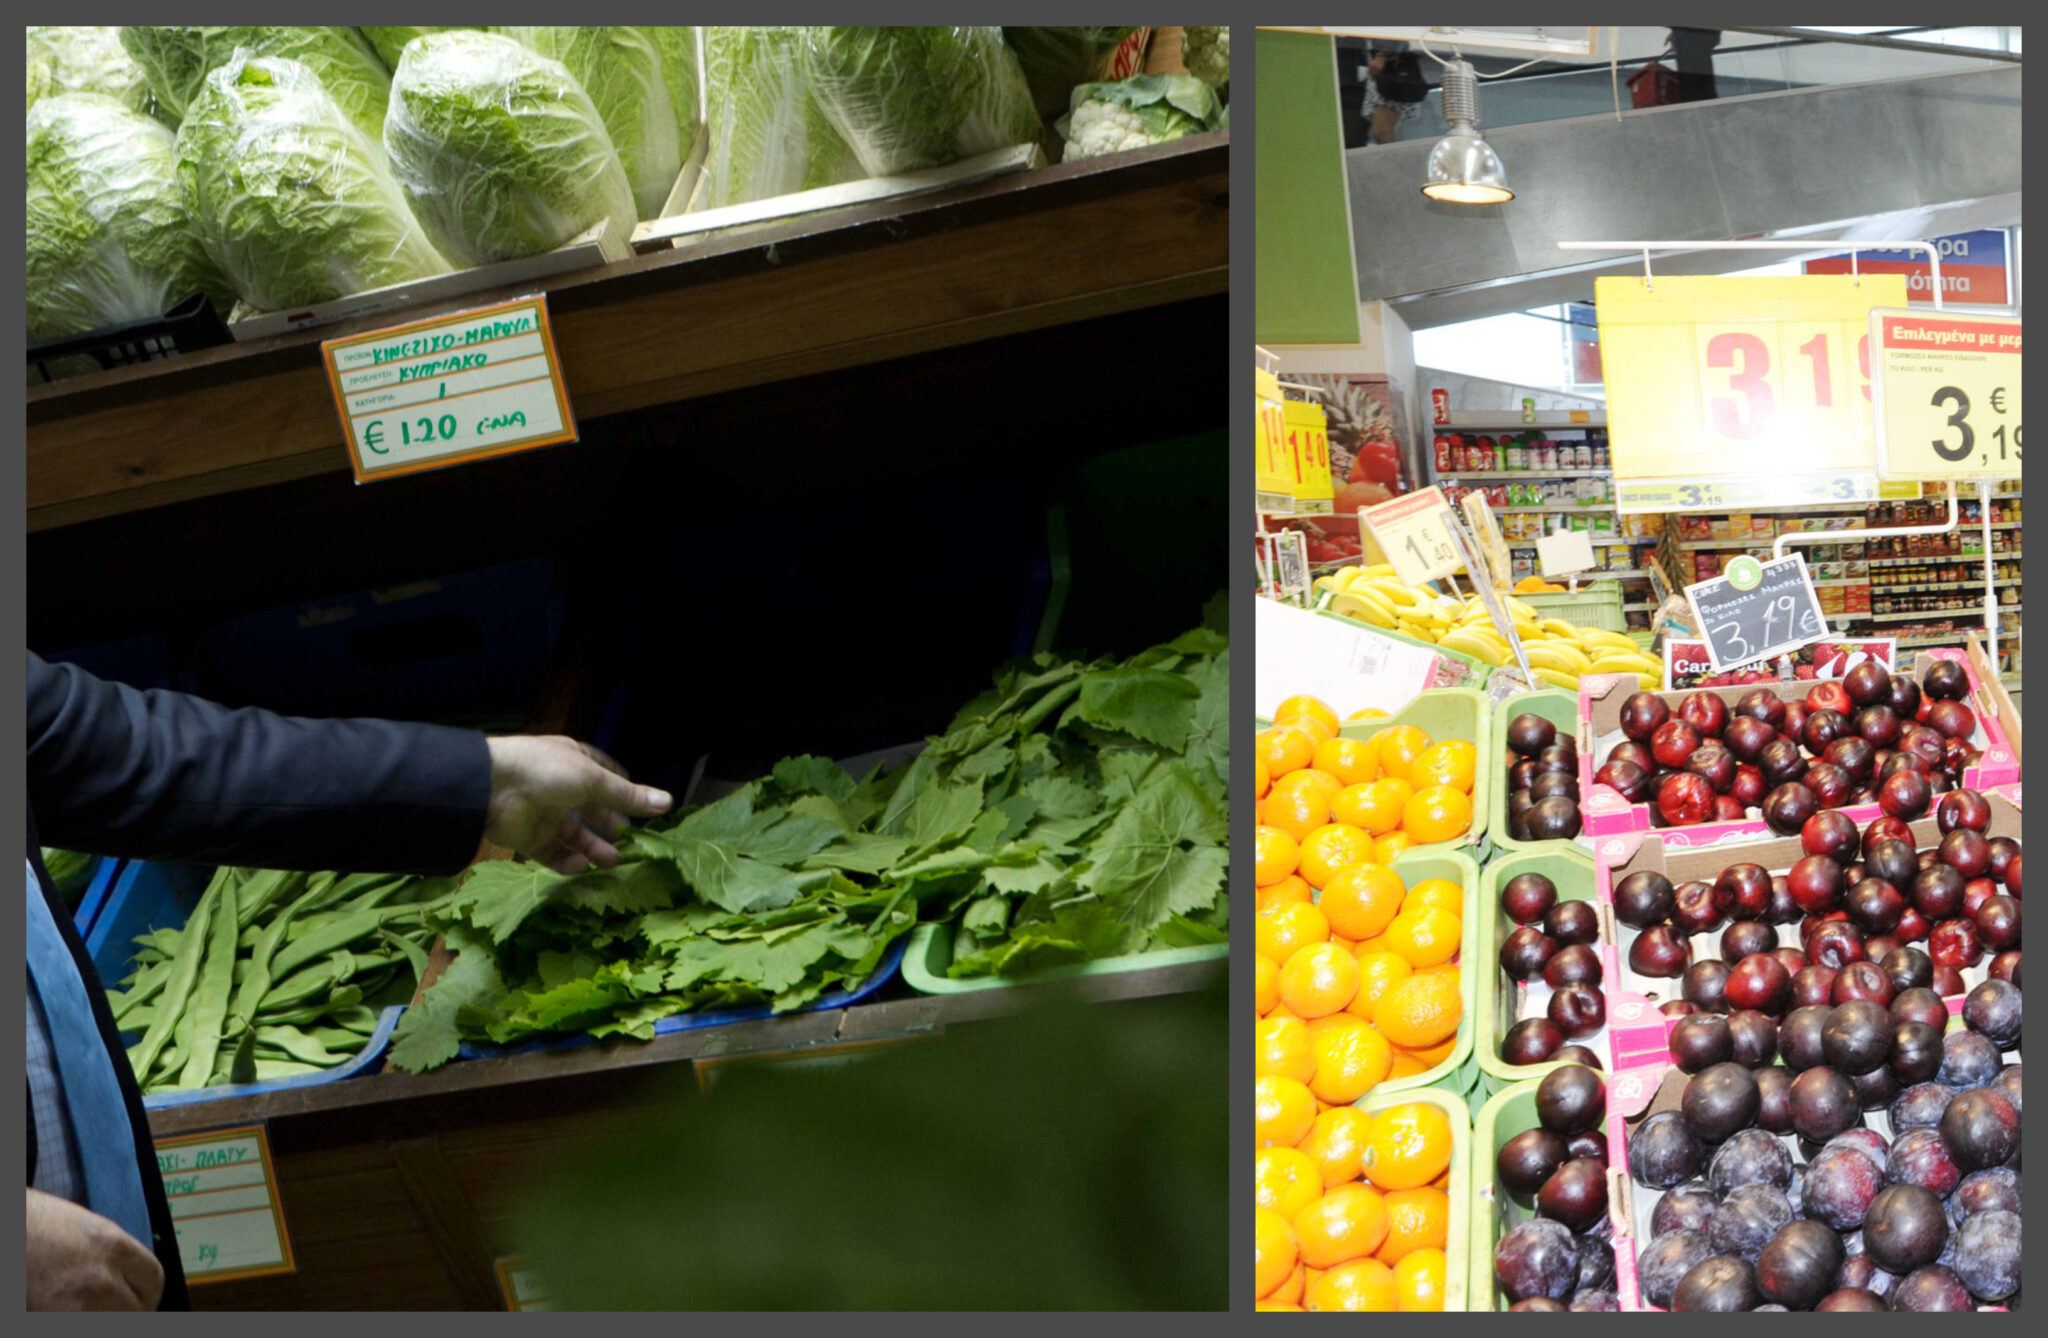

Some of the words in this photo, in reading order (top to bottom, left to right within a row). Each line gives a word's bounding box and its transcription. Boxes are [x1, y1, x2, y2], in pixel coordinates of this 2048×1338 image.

[1893, 326, 1976, 344] Επιλεγμένα
[1979, 332, 1996, 347] με
[1989, 386, 2007, 414] €
[364, 420, 389, 455] €
